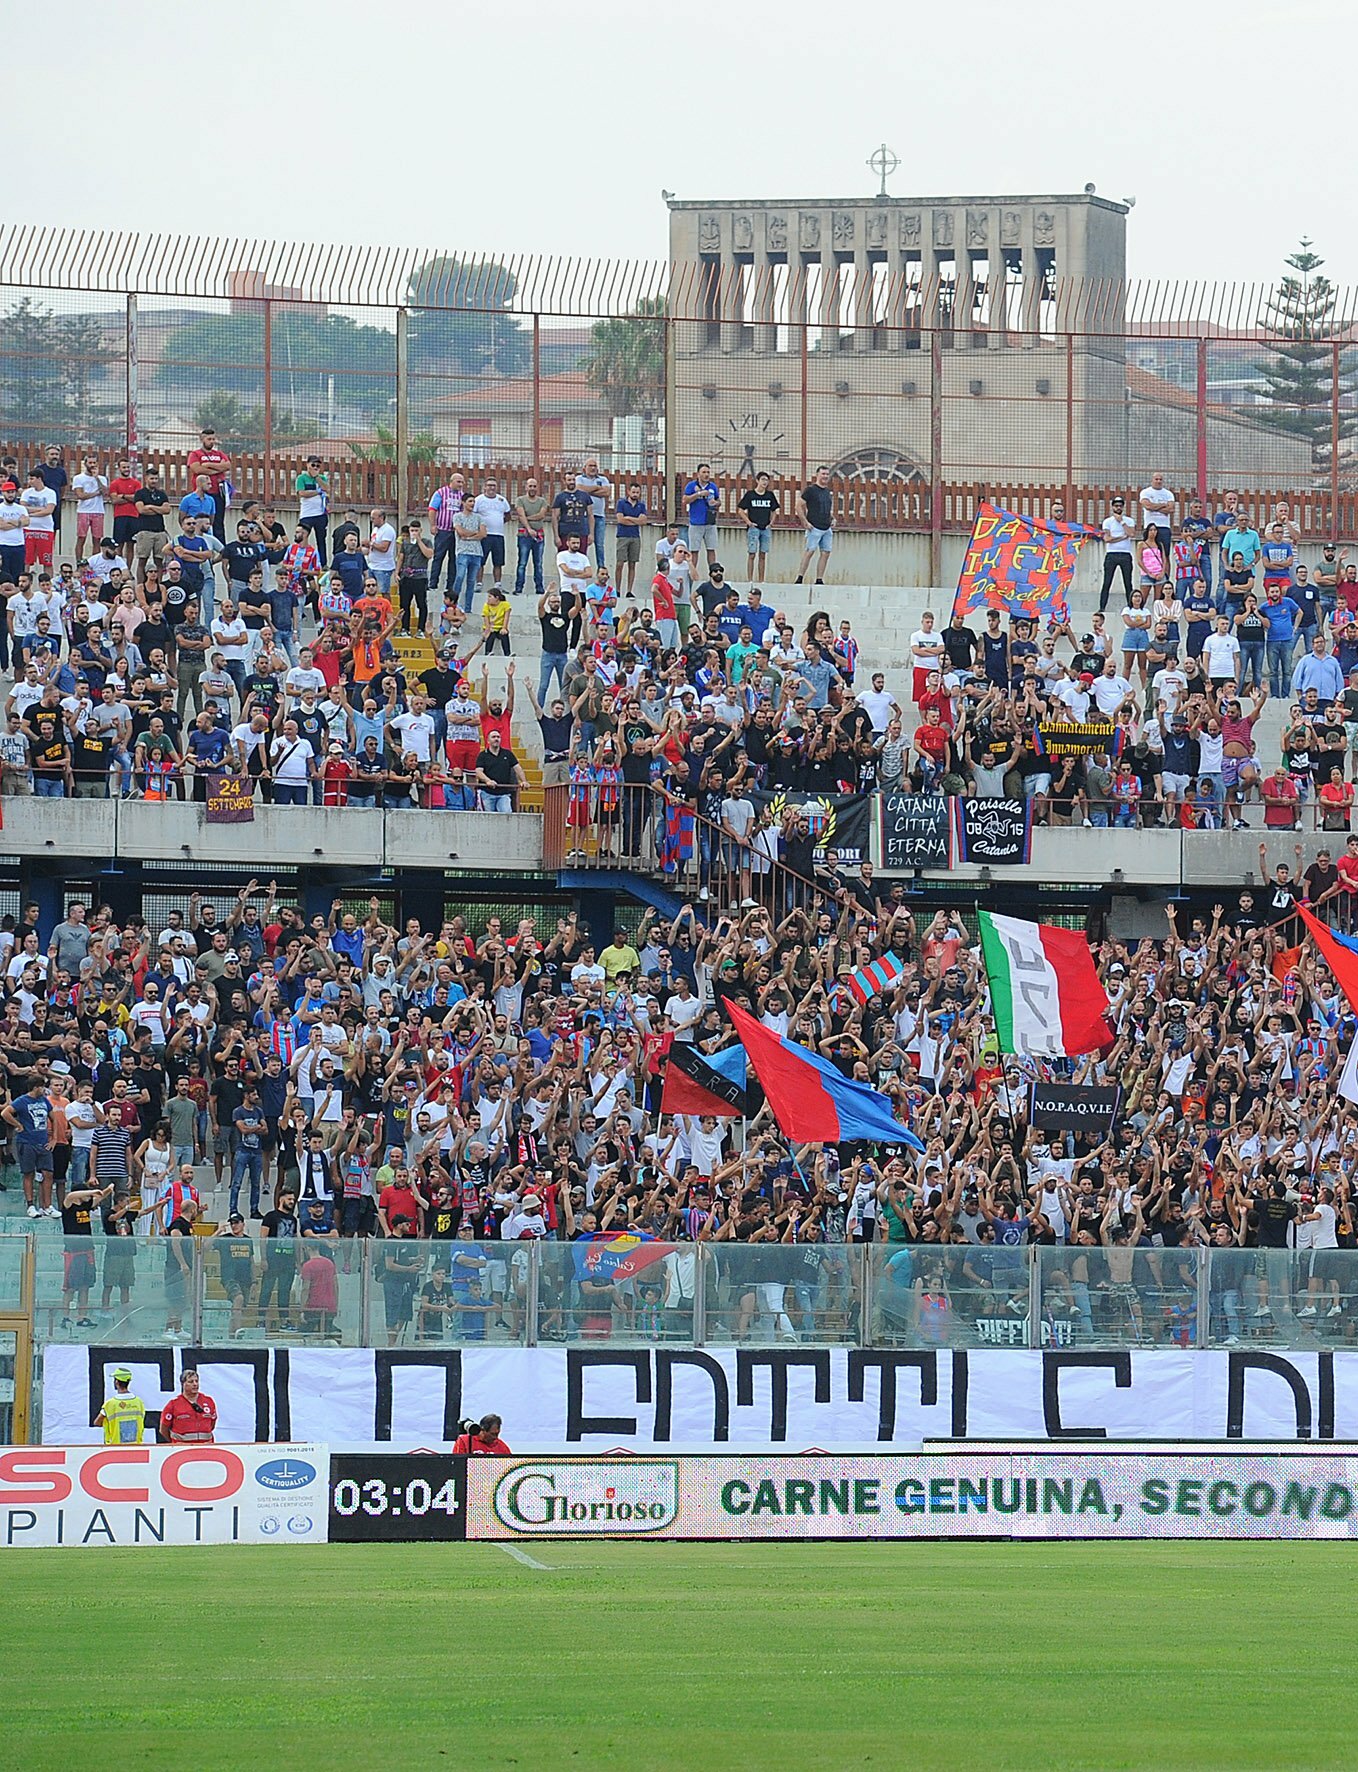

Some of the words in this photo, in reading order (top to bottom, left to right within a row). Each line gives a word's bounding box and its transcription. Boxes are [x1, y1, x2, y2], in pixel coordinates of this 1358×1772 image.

[219, 779, 241, 796] 24
[887, 797, 947, 814] CATANIA
[966, 799, 1023, 817] Paisello
[966, 822, 983, 835] 08
[888, 839, 947, 856] ETERNA
[971, 841, 1019, 856] Catania
[888, 857, 903, 866] 729
[260, 1474, 310, 1487] CERTIQUALITY
[333, 1478, 460, 1516] 03:04
[507, 1472, 667, 1525] Glorioso
[720, 1478, 883, 1516] CARNE
[893, 1478, 1124, 1523] GENUINA,
